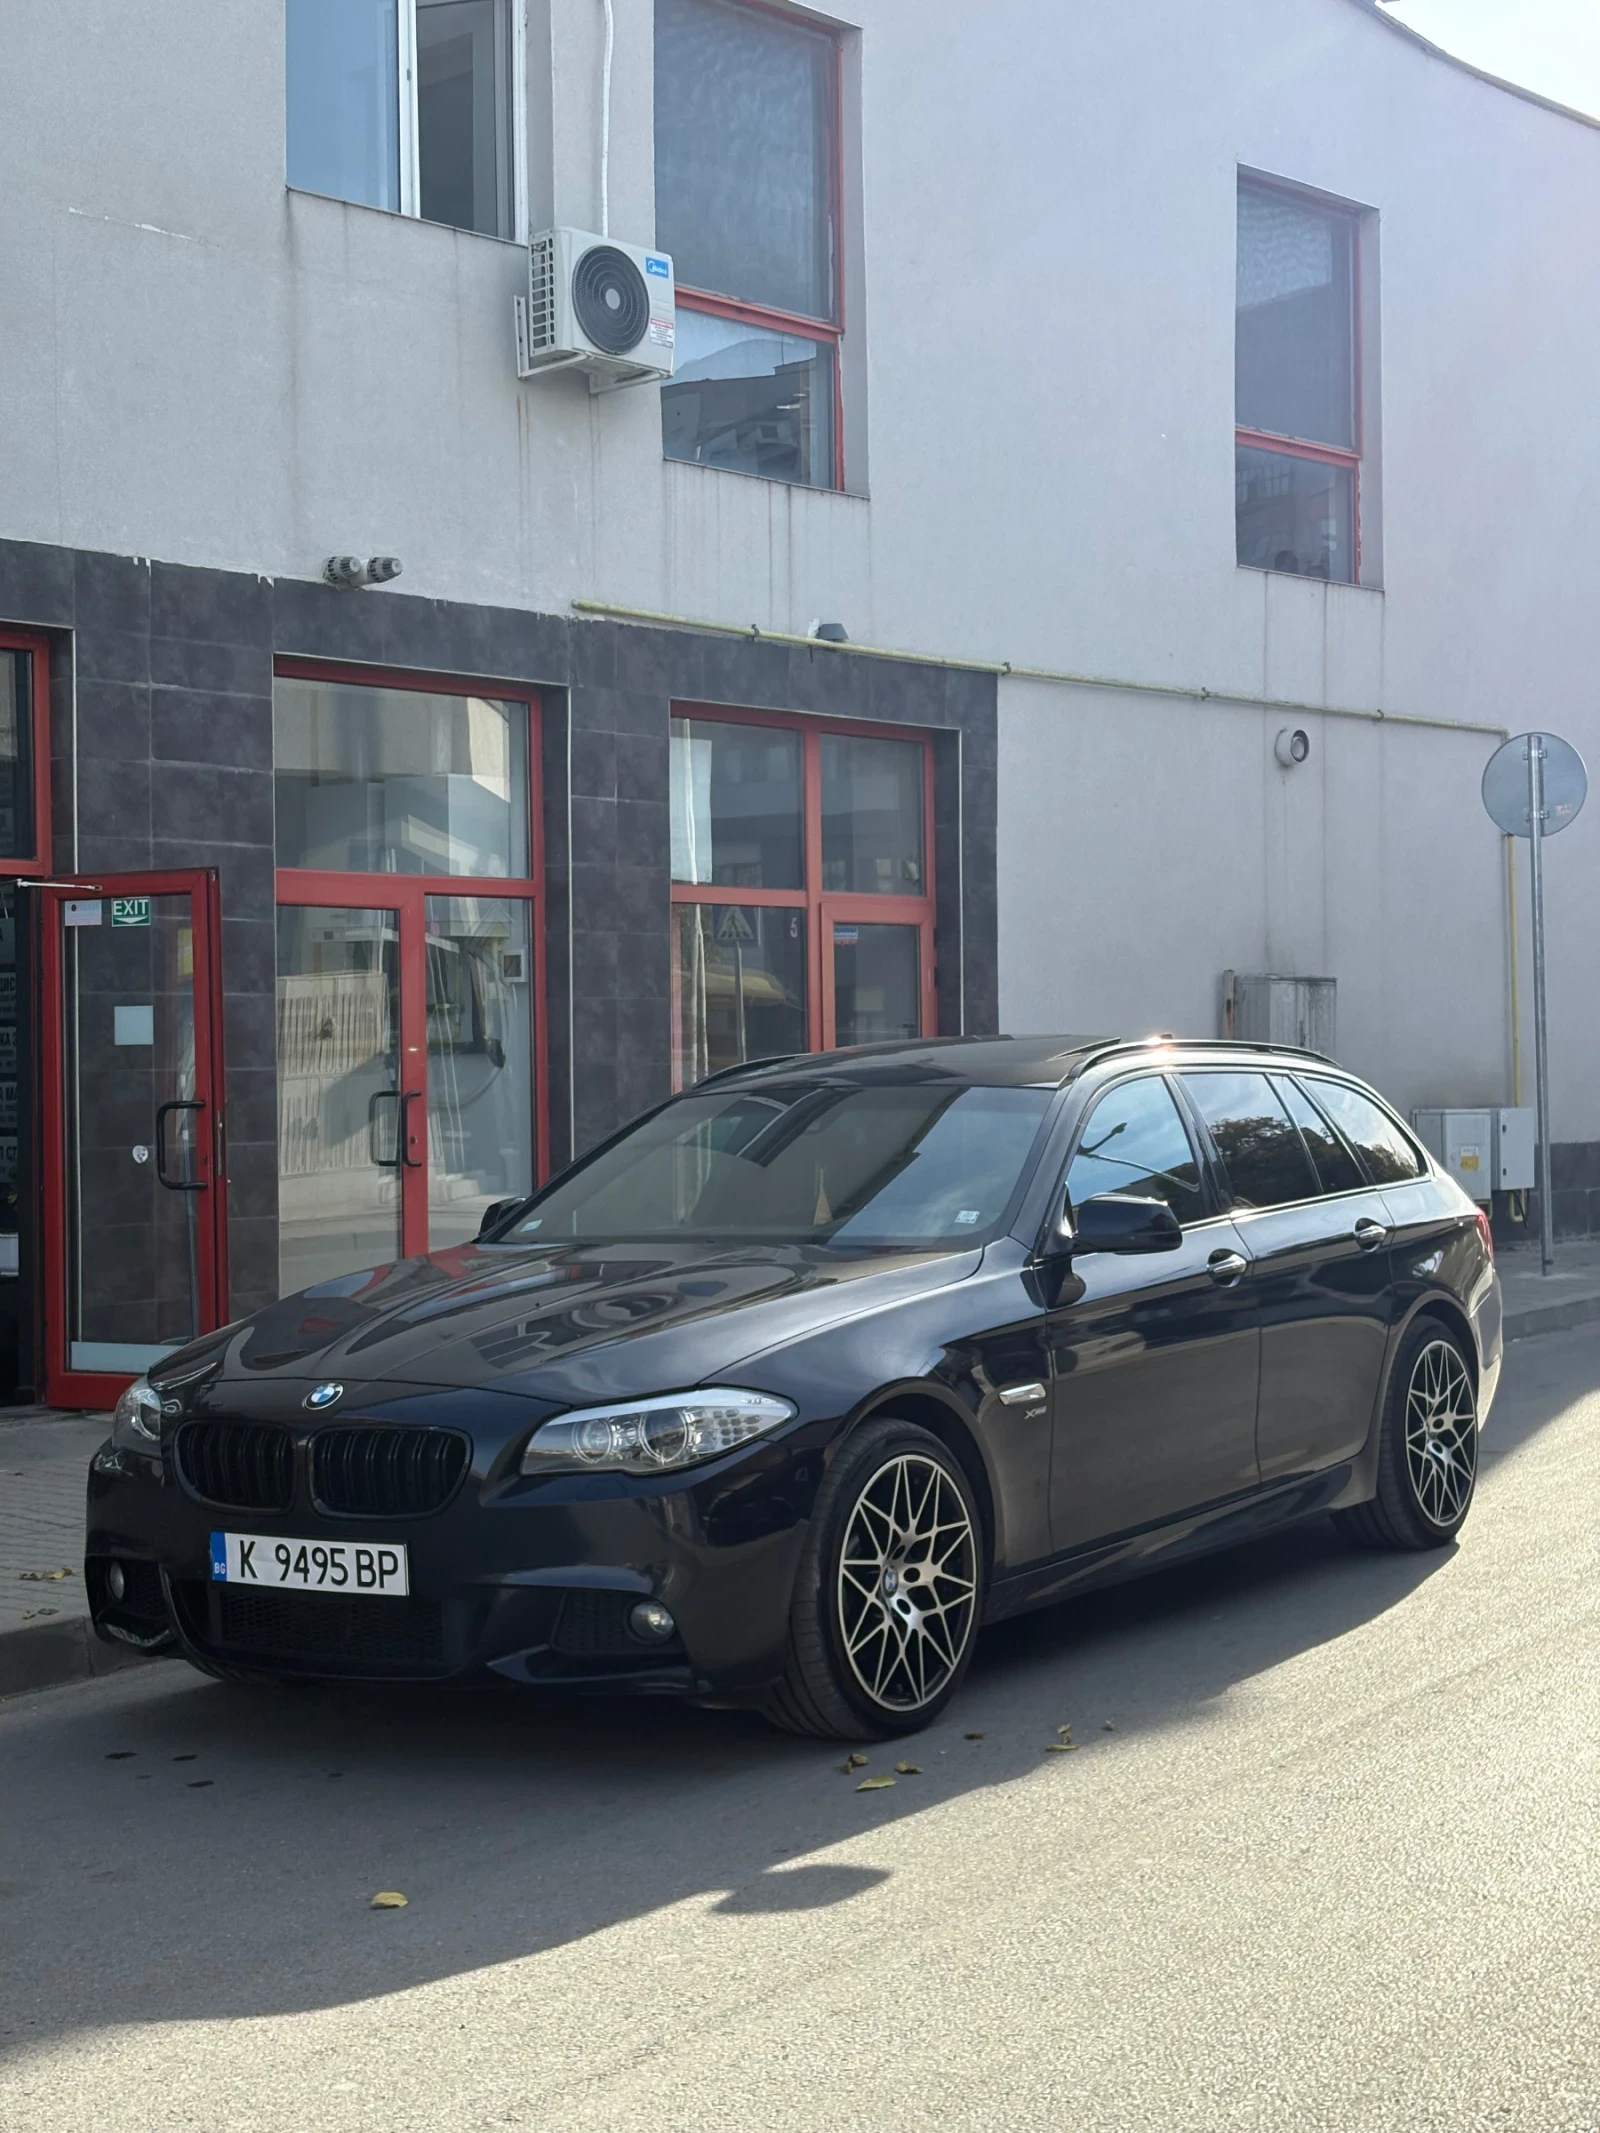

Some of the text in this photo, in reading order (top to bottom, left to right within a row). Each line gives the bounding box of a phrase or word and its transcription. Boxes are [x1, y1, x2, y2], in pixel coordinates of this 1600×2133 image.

[649, 261, 668, 275] Midea
[113, 899, 149, 916] EXIT
[214, 1562, 226, 1575] BG
[239, 1540, 399, 1589] K 9495 BP
